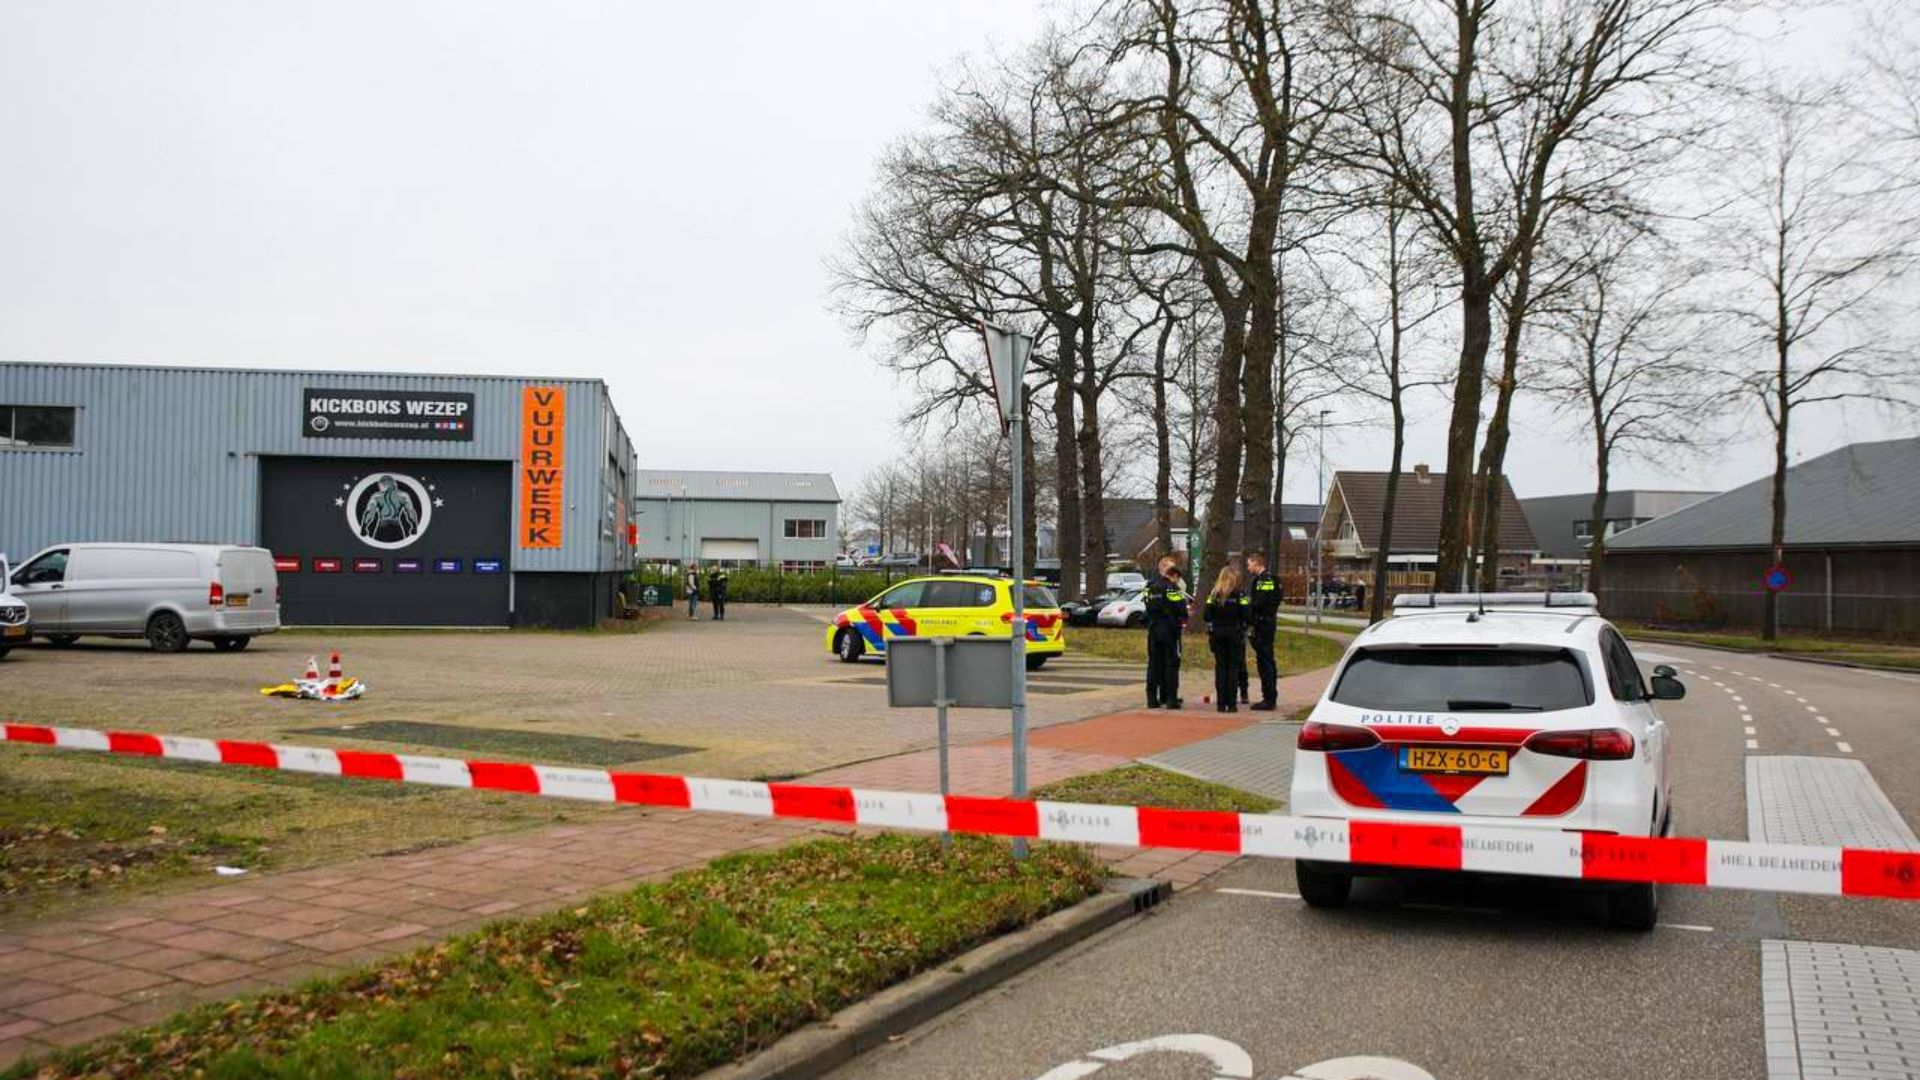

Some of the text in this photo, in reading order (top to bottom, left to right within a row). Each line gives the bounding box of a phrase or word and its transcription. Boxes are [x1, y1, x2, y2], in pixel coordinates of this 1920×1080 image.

[309, 398, 469, 416] KICKBOKS WEZEP
[526, 391, 557, 543] VUURWERK
[1361, 714, 1435, 724] POLITIE
[1413, 750, 1500, 769] HZX-60-G
